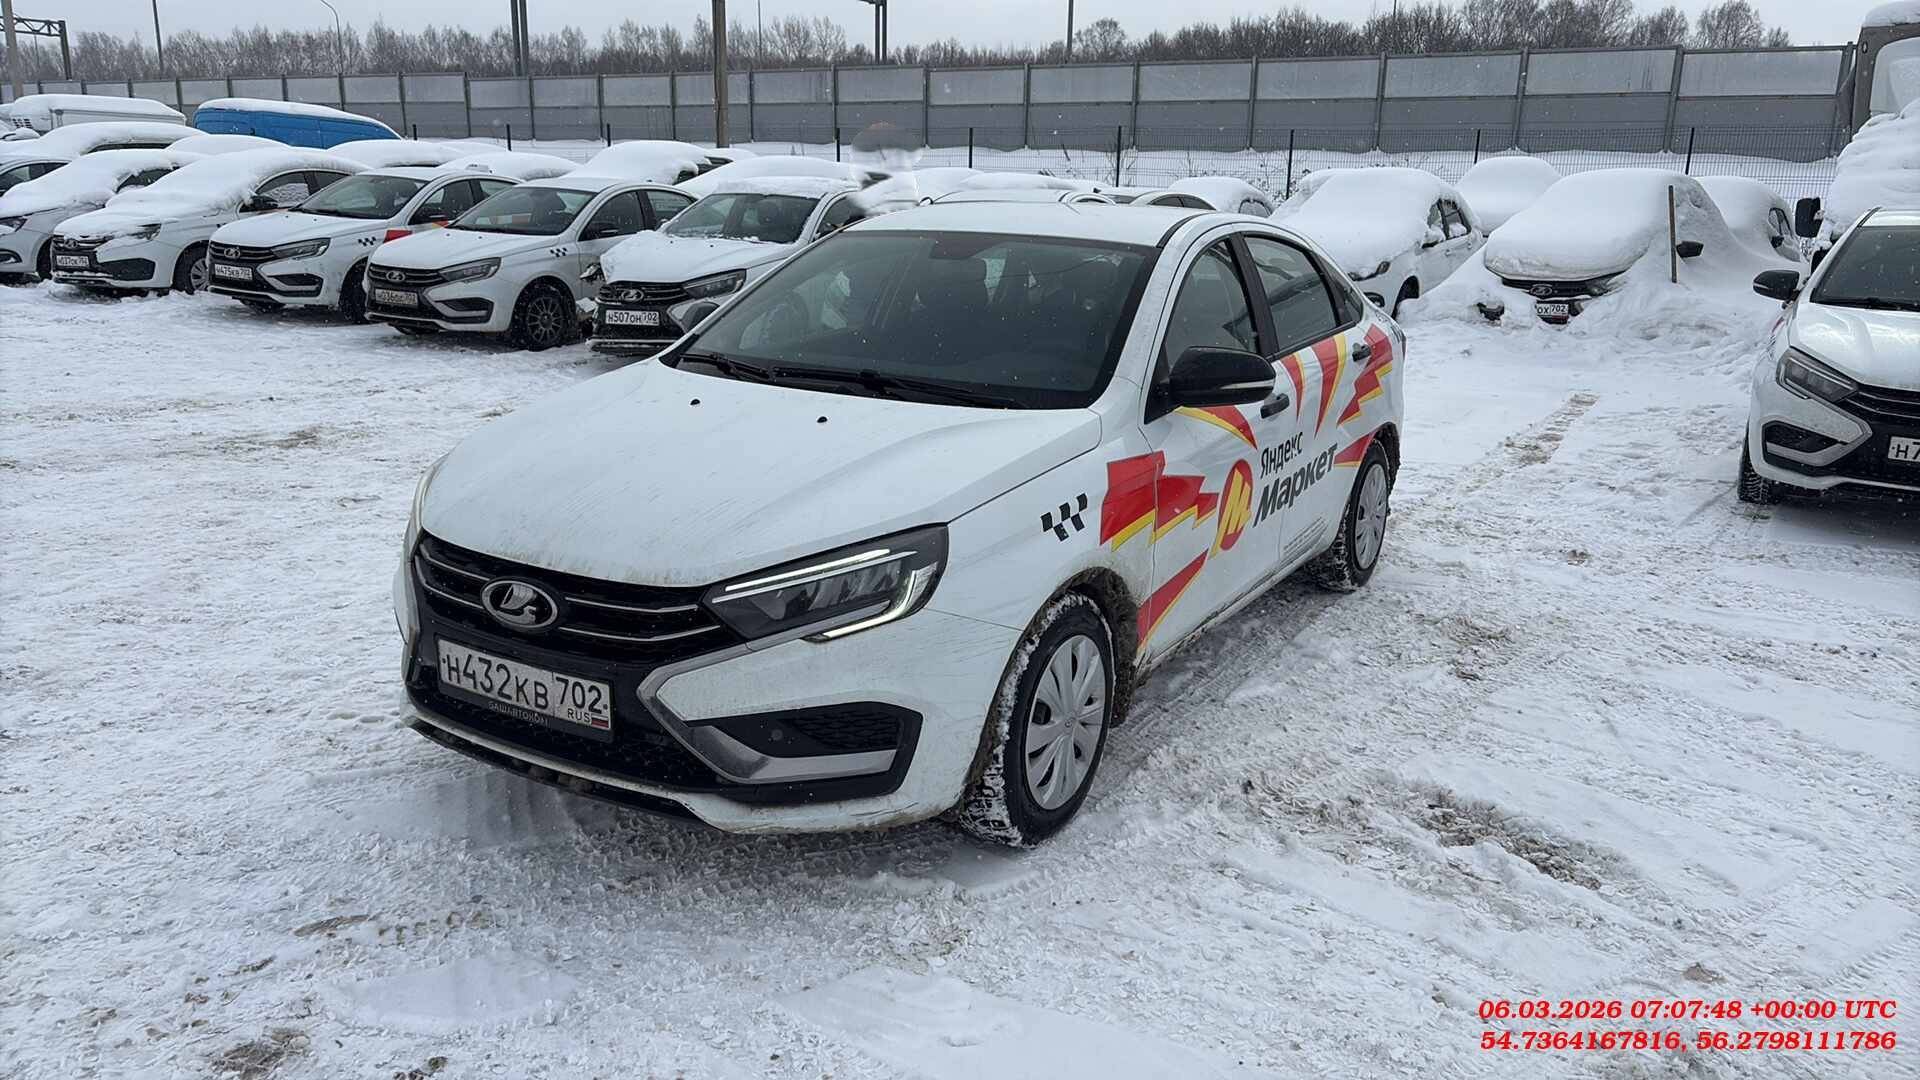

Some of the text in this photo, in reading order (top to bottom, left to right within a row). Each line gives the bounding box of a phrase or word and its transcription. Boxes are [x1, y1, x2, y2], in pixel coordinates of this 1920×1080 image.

[608, 311, 658, 323] Н507ОН 702
[1551, 304, 1566, 313] 702
[1260, 432, 1303, 480] Яндекс
[1252, 442, 1338, 528] Маркет
[446, 653, 602, 714] Н432КВ 702
[567, 708, 592, 723] RUS
